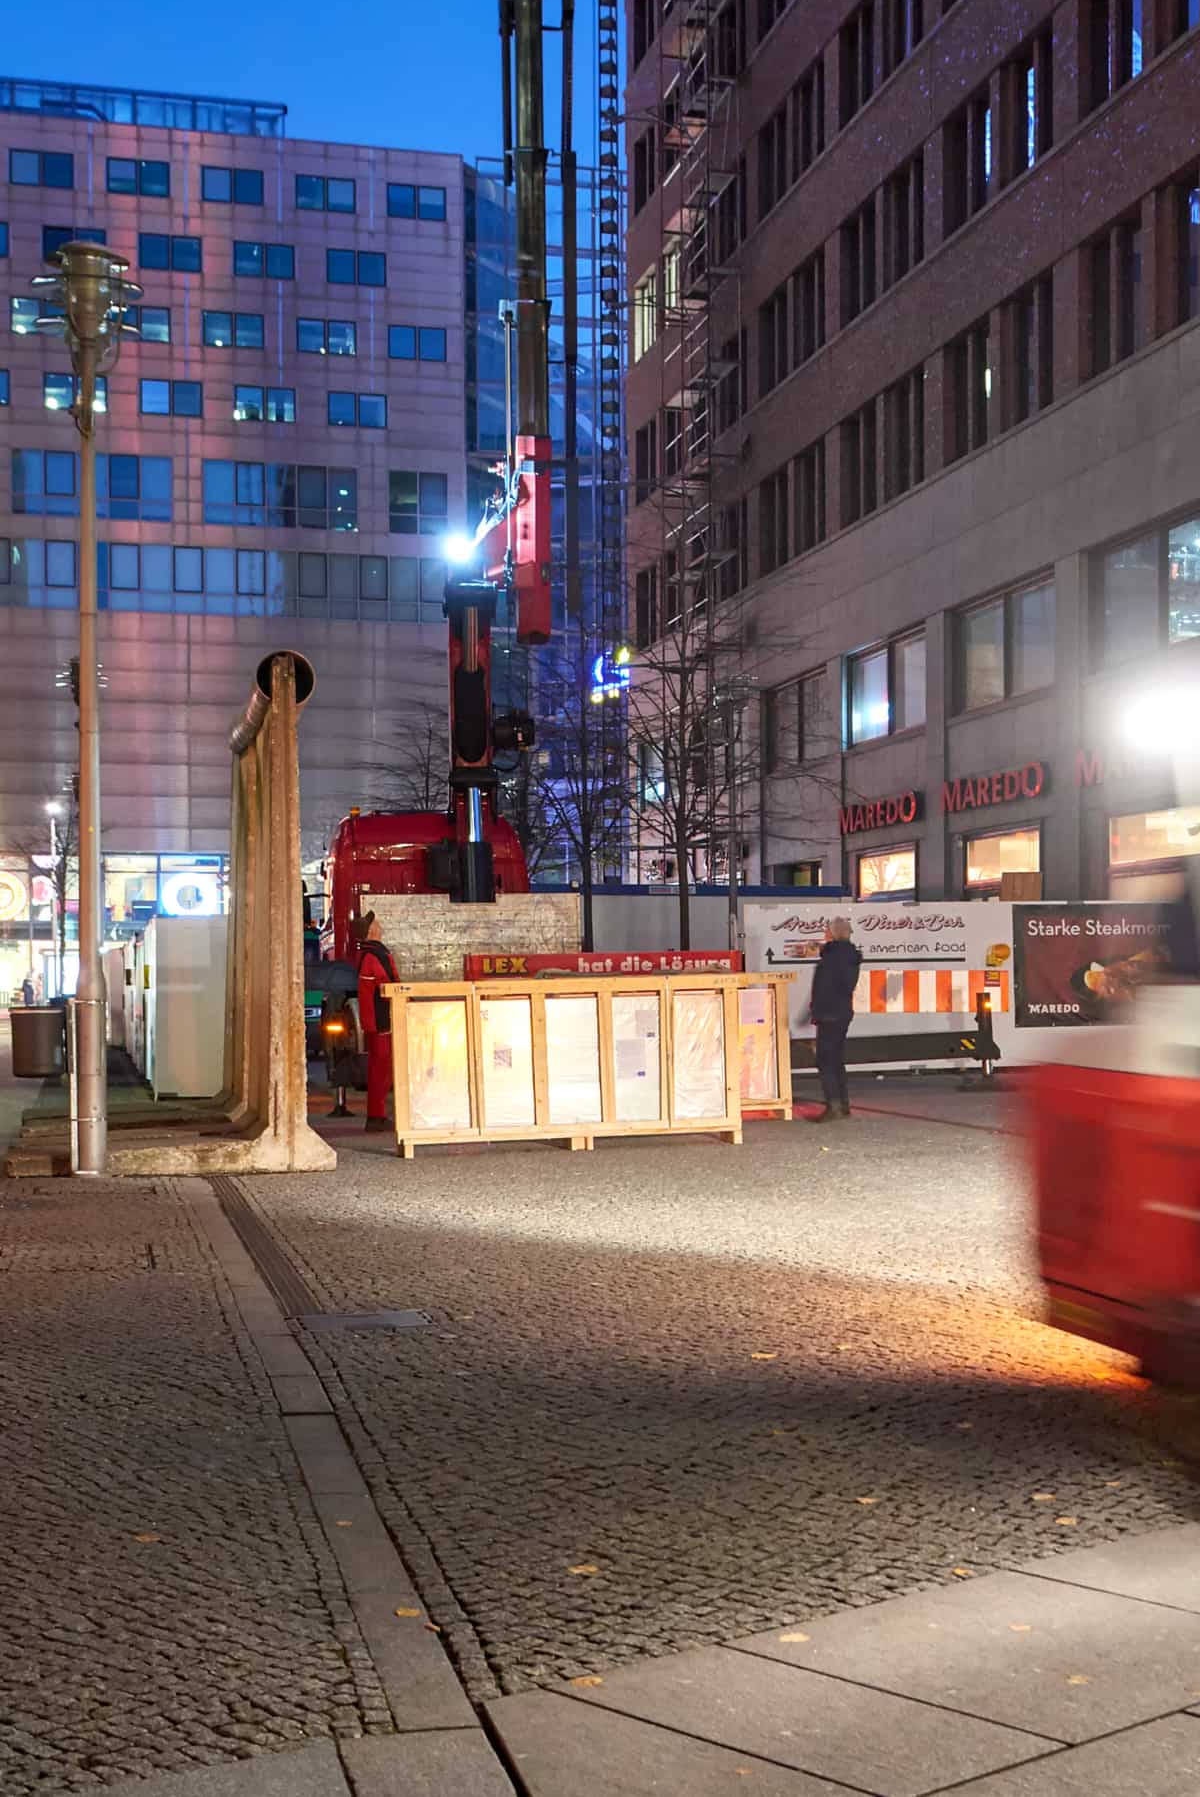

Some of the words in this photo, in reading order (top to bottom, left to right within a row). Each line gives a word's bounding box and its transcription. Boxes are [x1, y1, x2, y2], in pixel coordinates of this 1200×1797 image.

[941, 761, 1044, 812] MAREDO
[838, 789, 917, 835] MAREDO
[1027, 918, 1081, 937] Starke
[869, 943, 930, 954] american
[933, 941, 966, 953] food
[482, 956, 528, 974] LEX
[577, 957, 613, 973] hat
[620, 956, 653, 972] die
[1027, 1003, 1081, 1015] MAREDO
